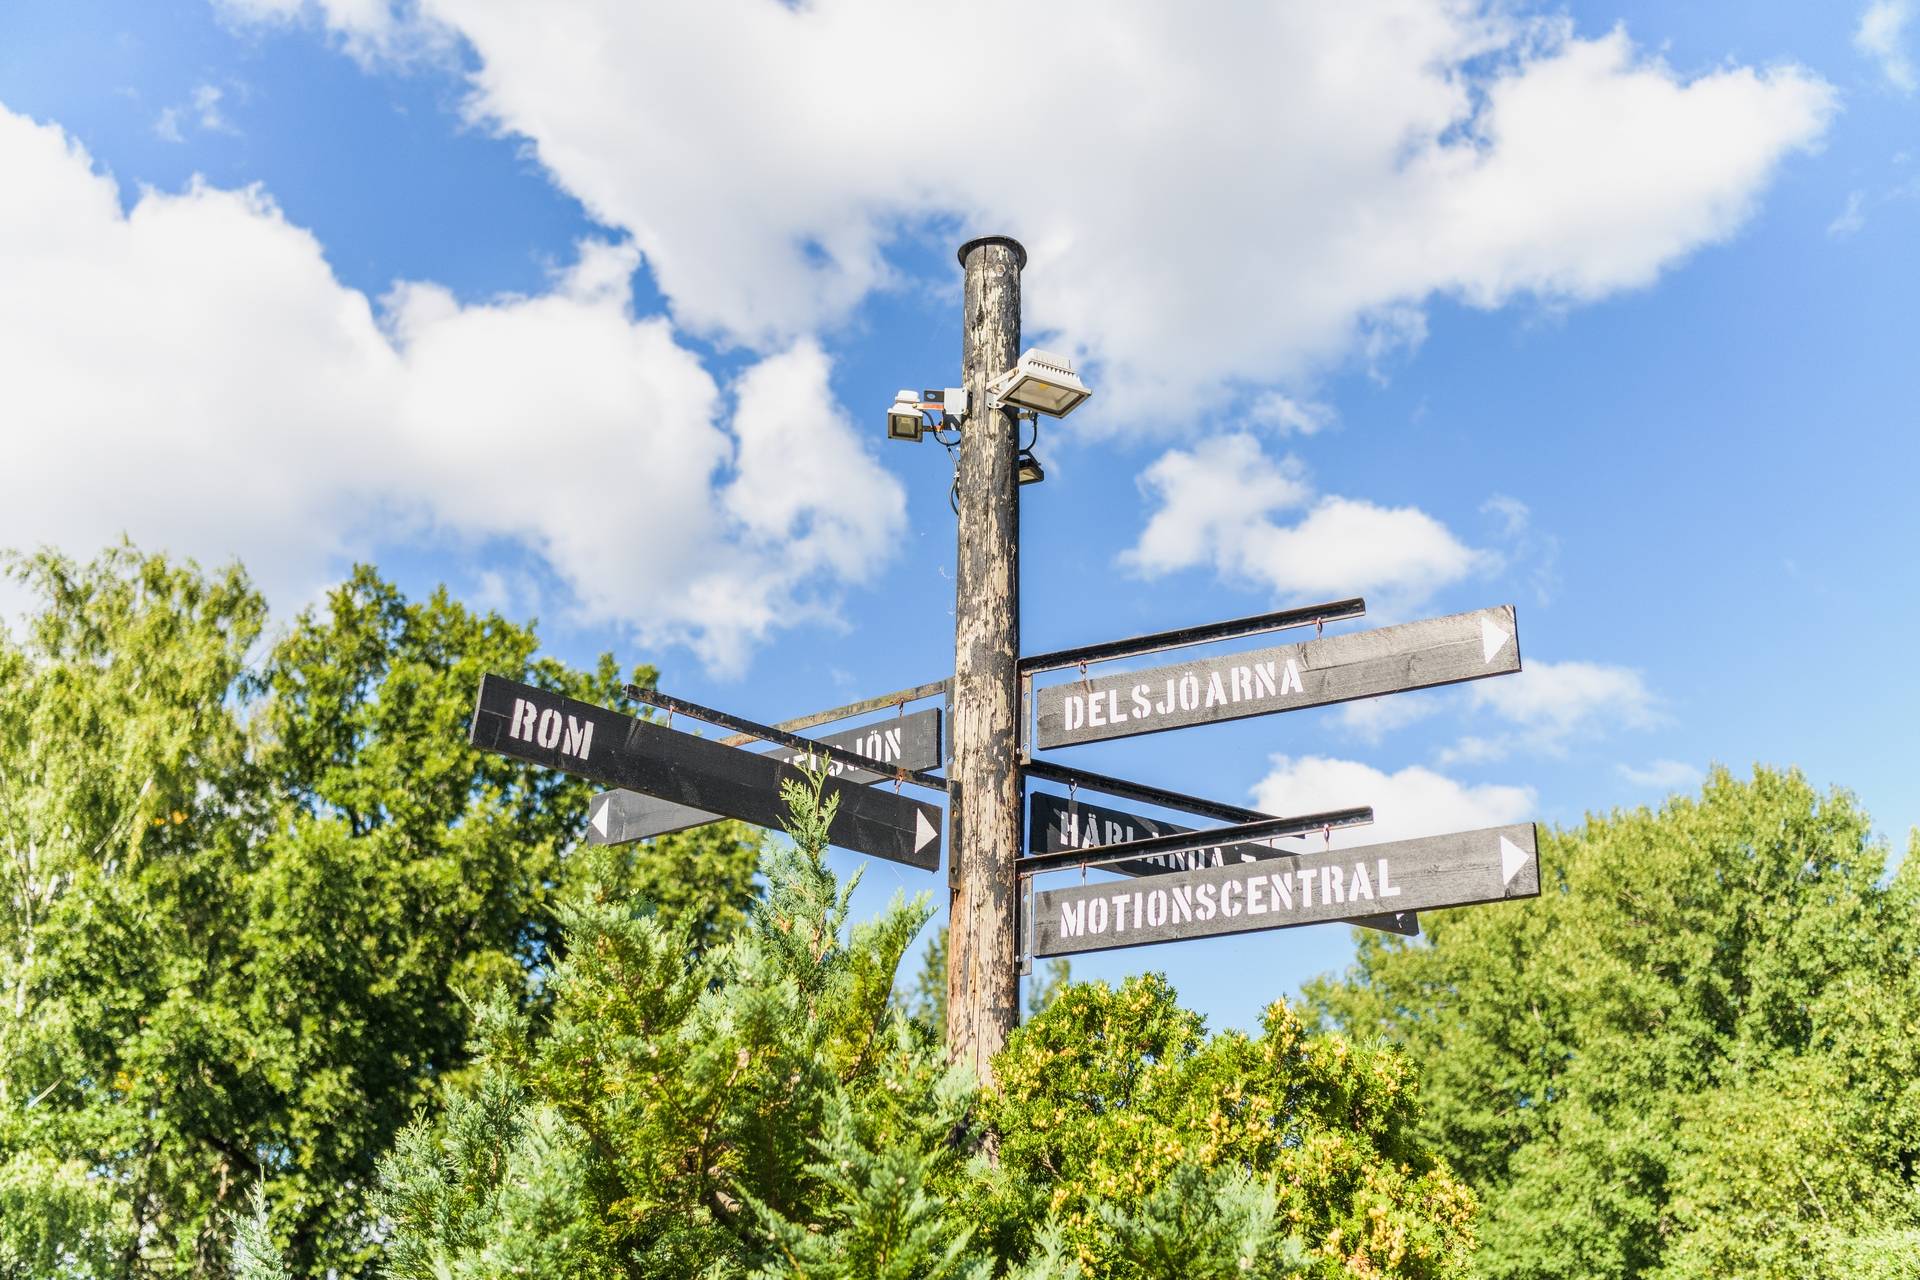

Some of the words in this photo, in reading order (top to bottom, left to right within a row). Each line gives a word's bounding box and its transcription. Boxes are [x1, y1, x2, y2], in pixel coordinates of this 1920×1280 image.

[1064, 659, 1304, 731] DELSJÖARNA
[509, 698, 594, 760] ROM
[784, 727, 901, 777] SJÖN
[1061, 859, 1401, 938] MOTIONSCENTRAL
